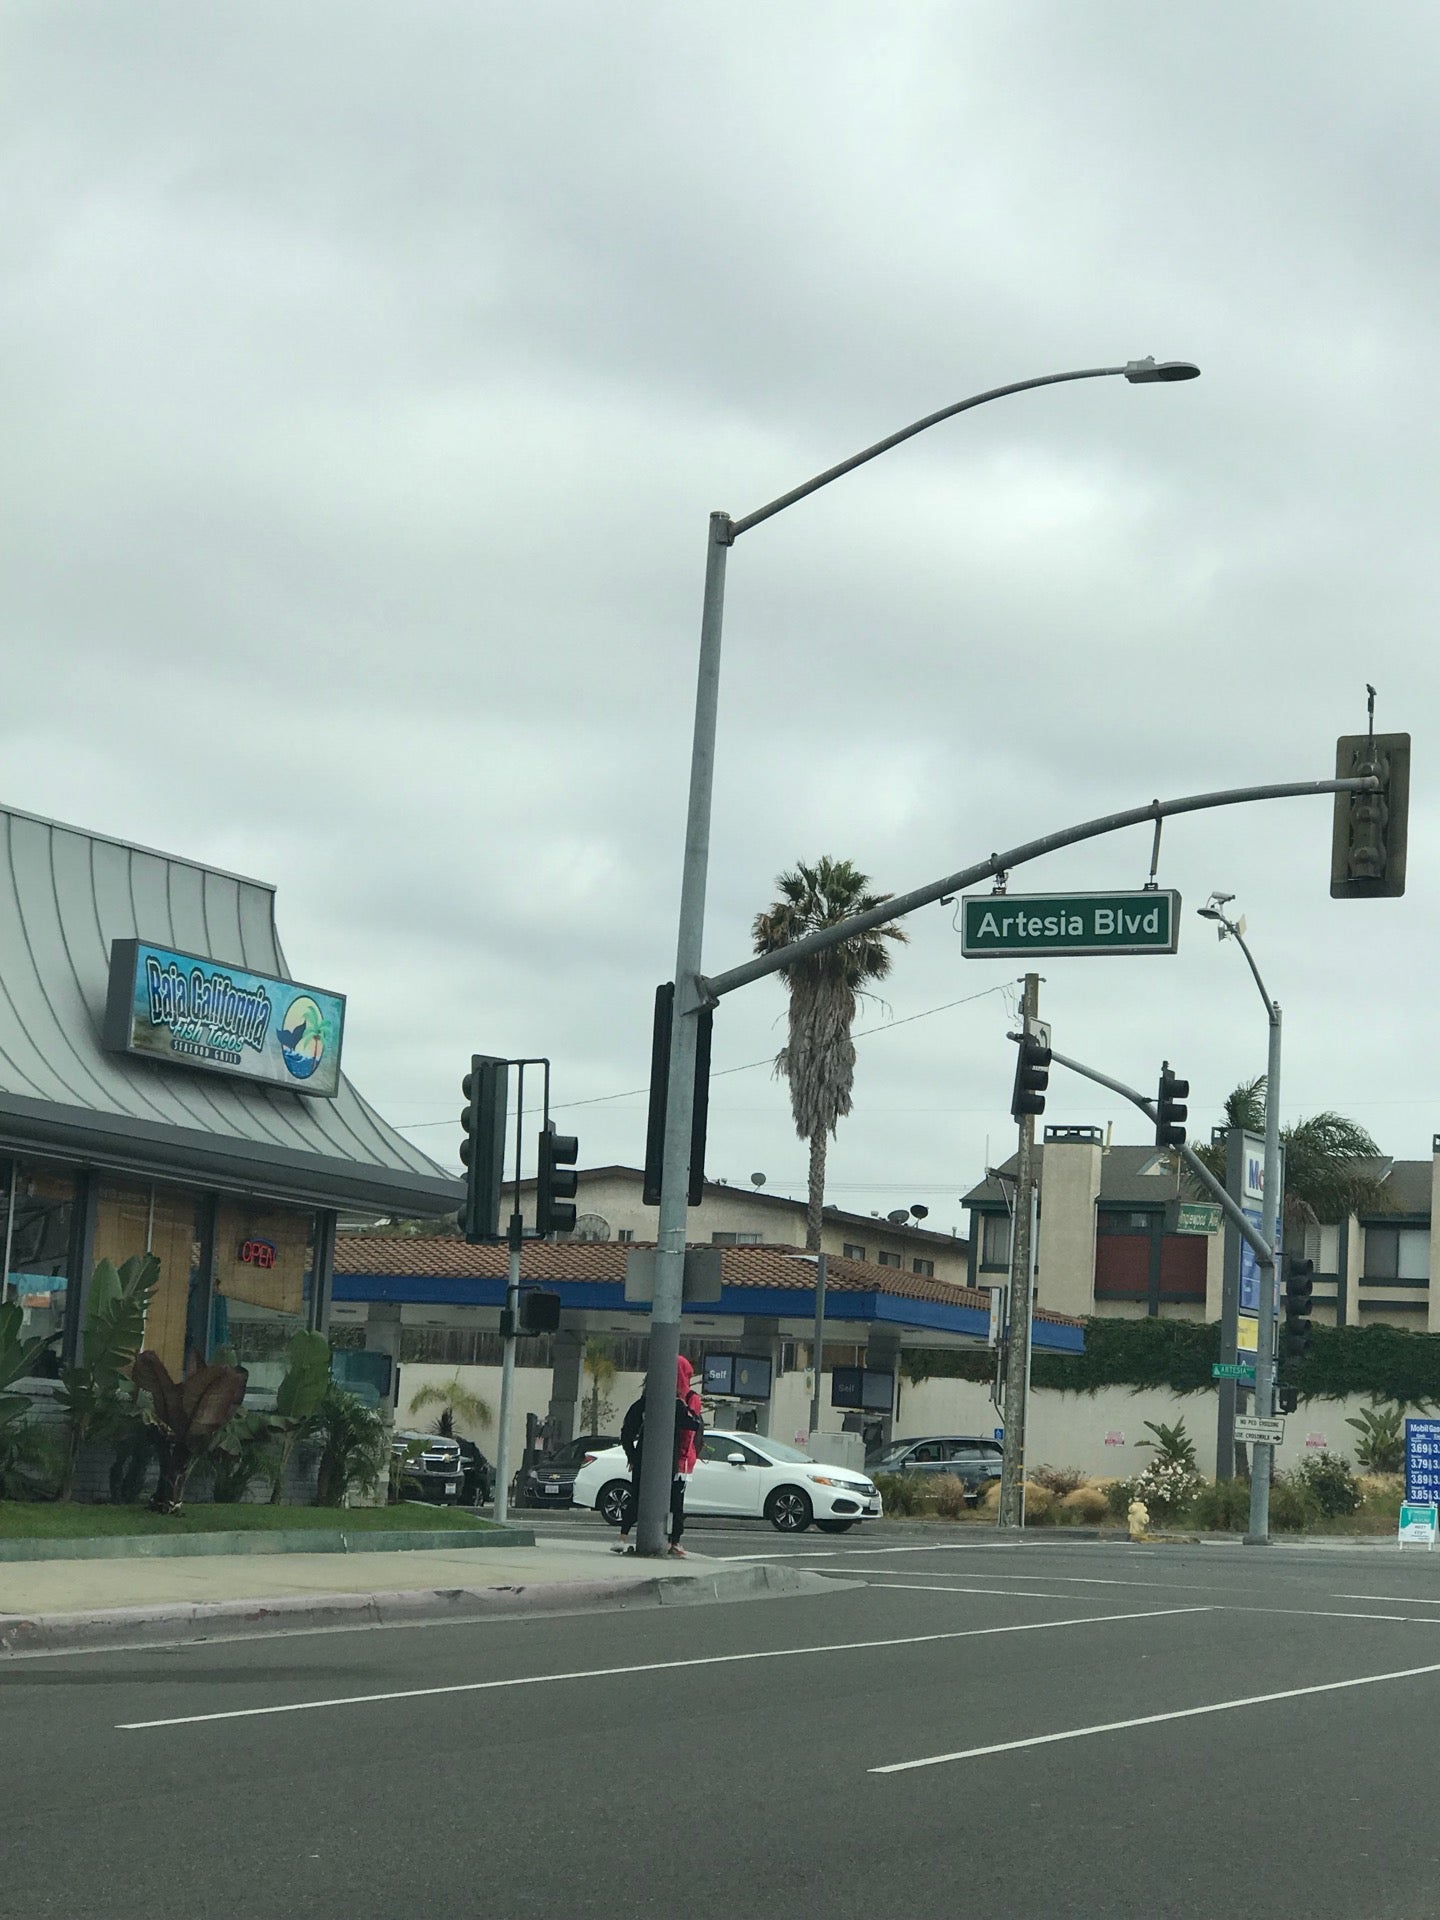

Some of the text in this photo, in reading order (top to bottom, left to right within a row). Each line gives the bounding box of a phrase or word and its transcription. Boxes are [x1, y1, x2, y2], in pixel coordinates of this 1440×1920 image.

[976, 907, 1159, 938] Artesia Blvd
[146, 956, 271, 1051] Baja California
[173, 1017, 244, 1051] Fish Tacos
[242, 1240, 276, 1269] OPEN
[709, 1370, 727, 1380] Self
[1220, 1365, 1247, 1375] ARTESIA
[838, 1384, 855, 1393] Self
[1410, 1423, 1428, 1433] Mobil
